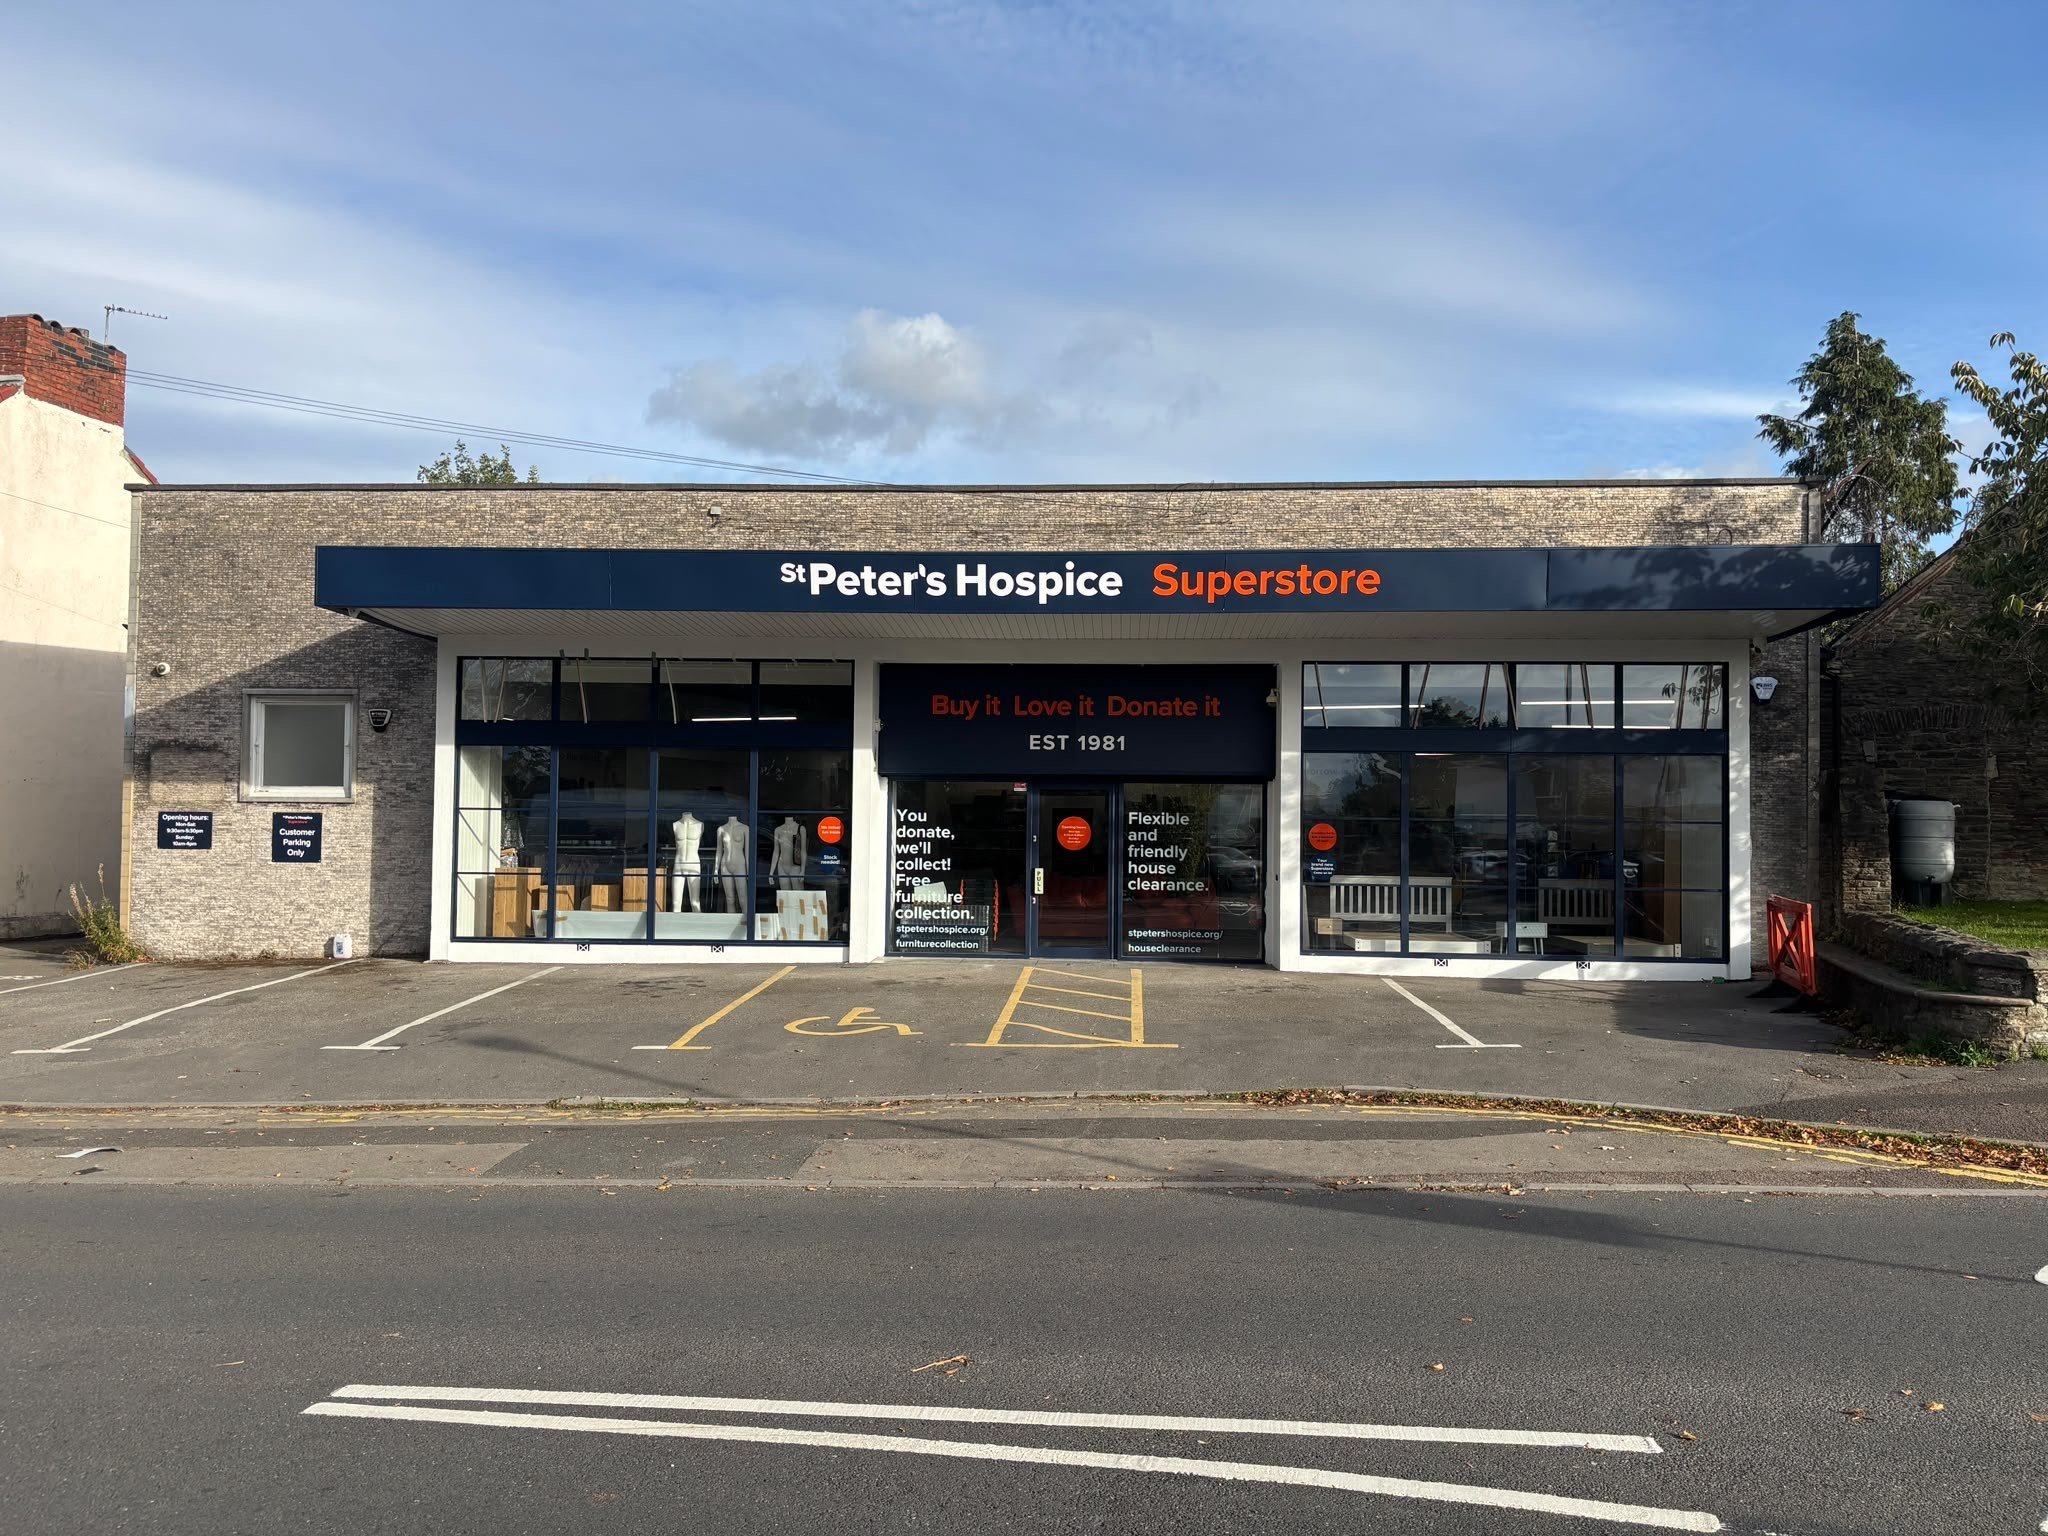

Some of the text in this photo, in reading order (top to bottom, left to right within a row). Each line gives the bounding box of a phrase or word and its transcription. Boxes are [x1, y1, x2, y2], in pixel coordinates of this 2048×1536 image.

[780, 560, 1381, 605] St Peter's Hospice Superstore
[931, 694, 1221, 721] Buy it Love it Donate it
[1028, 734, 1126, 751] EST 1981
[162, 813, 189, 822] Opening
[896, 808, 928, 822] You
[1128, 812, 1190, 826] Flexible
[279, 828, 316, 836] Customer
[896, 825, 956, 841] donate,
[1128, 828, 1158, 842] and
[283, 838, 311, 848] Parking
[896, 841, 932, 855] we'll
[286, 848, 305, 858] Only
[1128, 844, 1188, 862] friendly
[896, 857, 952, 871] collect!
[1128, 861, 1176, 875] house
[895, 873, 931, 887] Free
[1127, 877, 1209, 892] clearance.
[895, 906, 975, 920] collection.
[896, 940, 979, 950] furniturecollection
[1128, 943, 1202, 953] houseclearance
